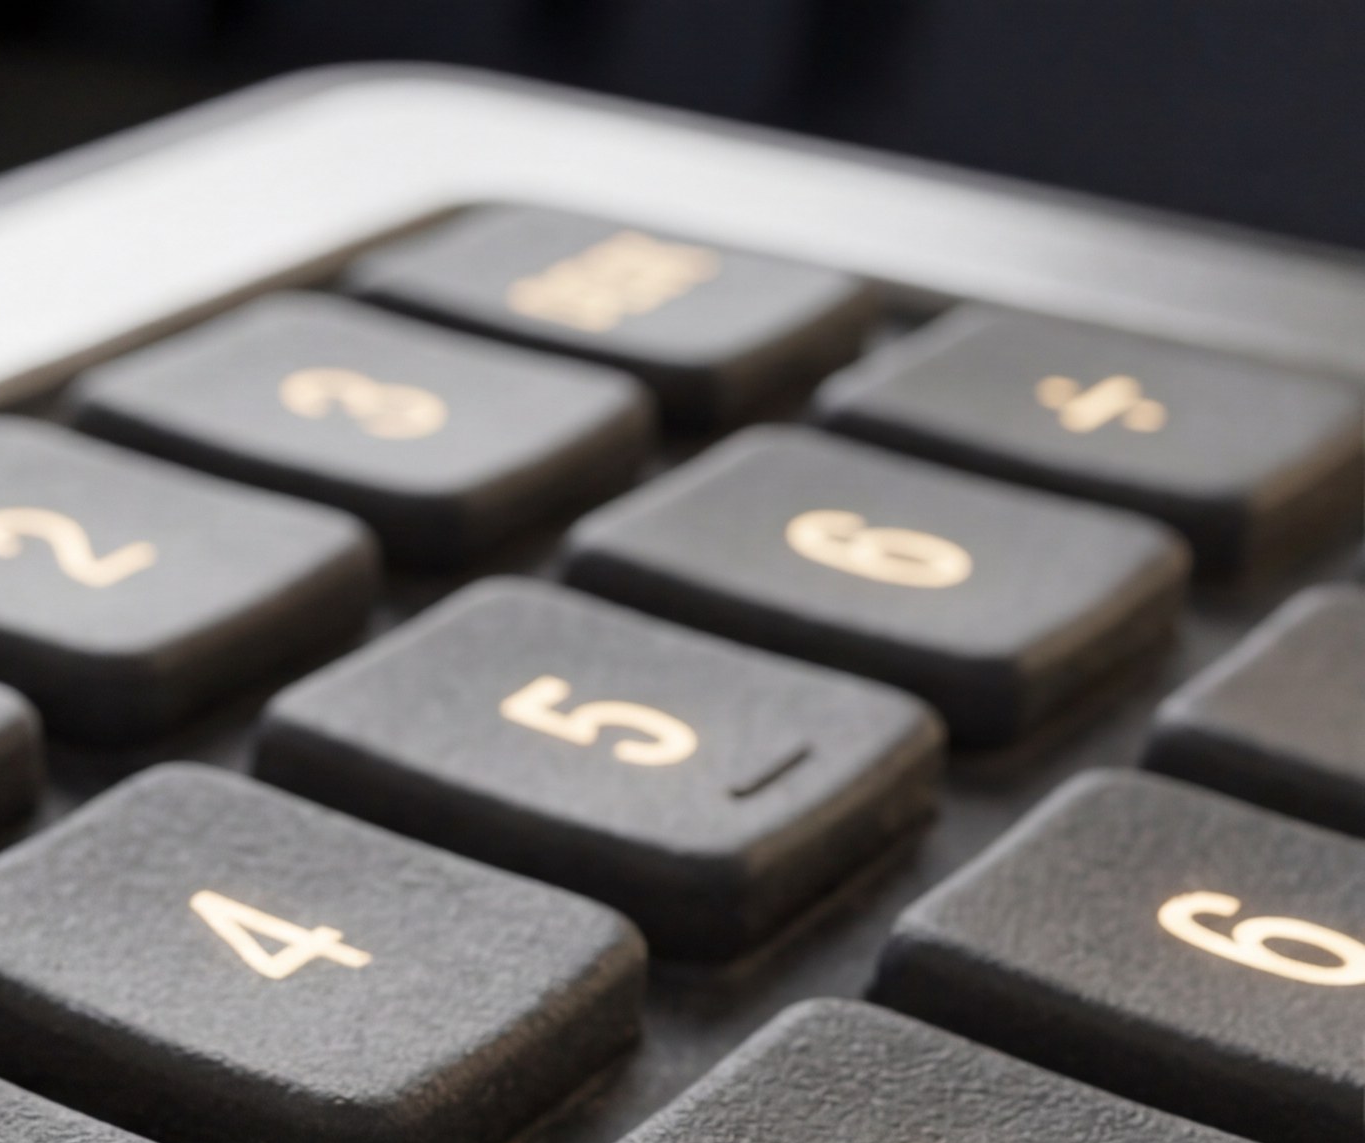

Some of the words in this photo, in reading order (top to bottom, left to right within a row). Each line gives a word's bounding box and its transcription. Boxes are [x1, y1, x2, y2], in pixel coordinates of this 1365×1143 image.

[279, 367, 447, 439] 3
[783, 508, 974, 589] 6
[499, 674, 699, 768] 5
[187, 888, 373, 981] 4
[1155, 889, 1365, 988] 6
